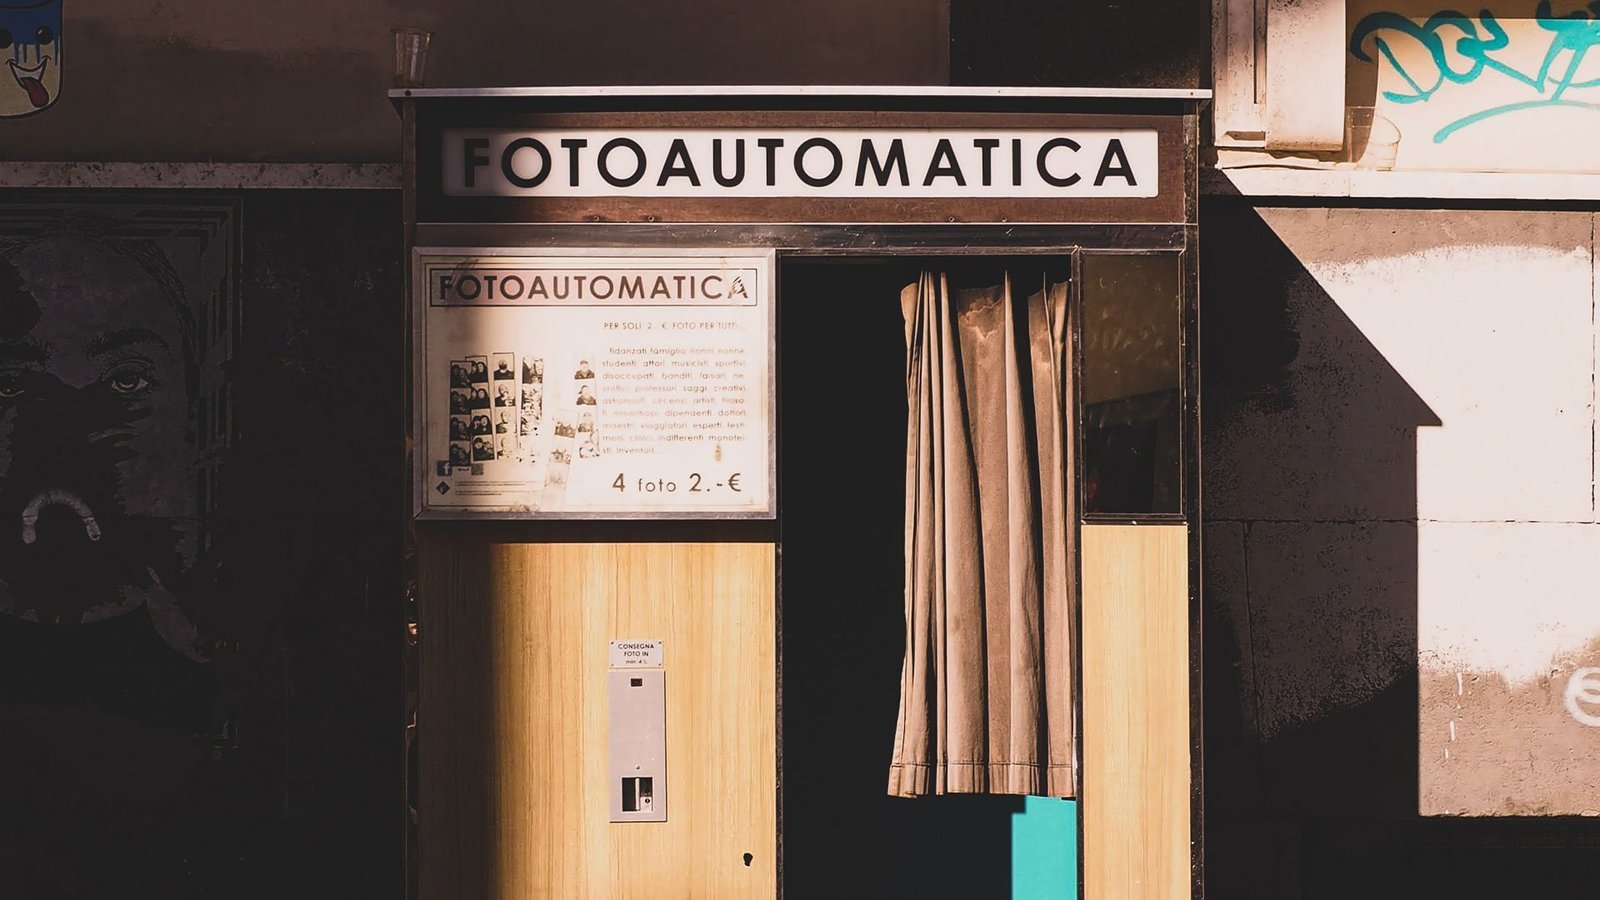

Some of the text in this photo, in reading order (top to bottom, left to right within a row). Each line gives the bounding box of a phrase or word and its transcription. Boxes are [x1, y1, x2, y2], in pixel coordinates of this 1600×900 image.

[464, 137, 1138, 188] FOTOAUTOMATICA
[440, 275, 749, 300] FOTOAUTOMATICA
[603, 322, 619, 330] PER
[622, 322, 642, 330] SOLI
[672, 322, 697, 330] FOTO
[699, 322, 715, 330] PER
[609, 347, 647, 355] fidanzati
[650, 347, 686, 357] famiglia
[717, 347, 745, 355] nonne
[602, 360, 746, 369] studenti attori musicisti sportivi
[602, 372, 654, 381] disoccupati
[661, 372, 693, 380] banditi
[684, 385, 707, 394] saggi
[665, 409, 712, 418] dipendenti
[718, 409, 746, 417] dottori
[693, 422, 722, 431] esperti
[658, 434, 704, 442] indifferenti
[612, 473, 626, 492] 4
[638, 478, 677, 493] foto
